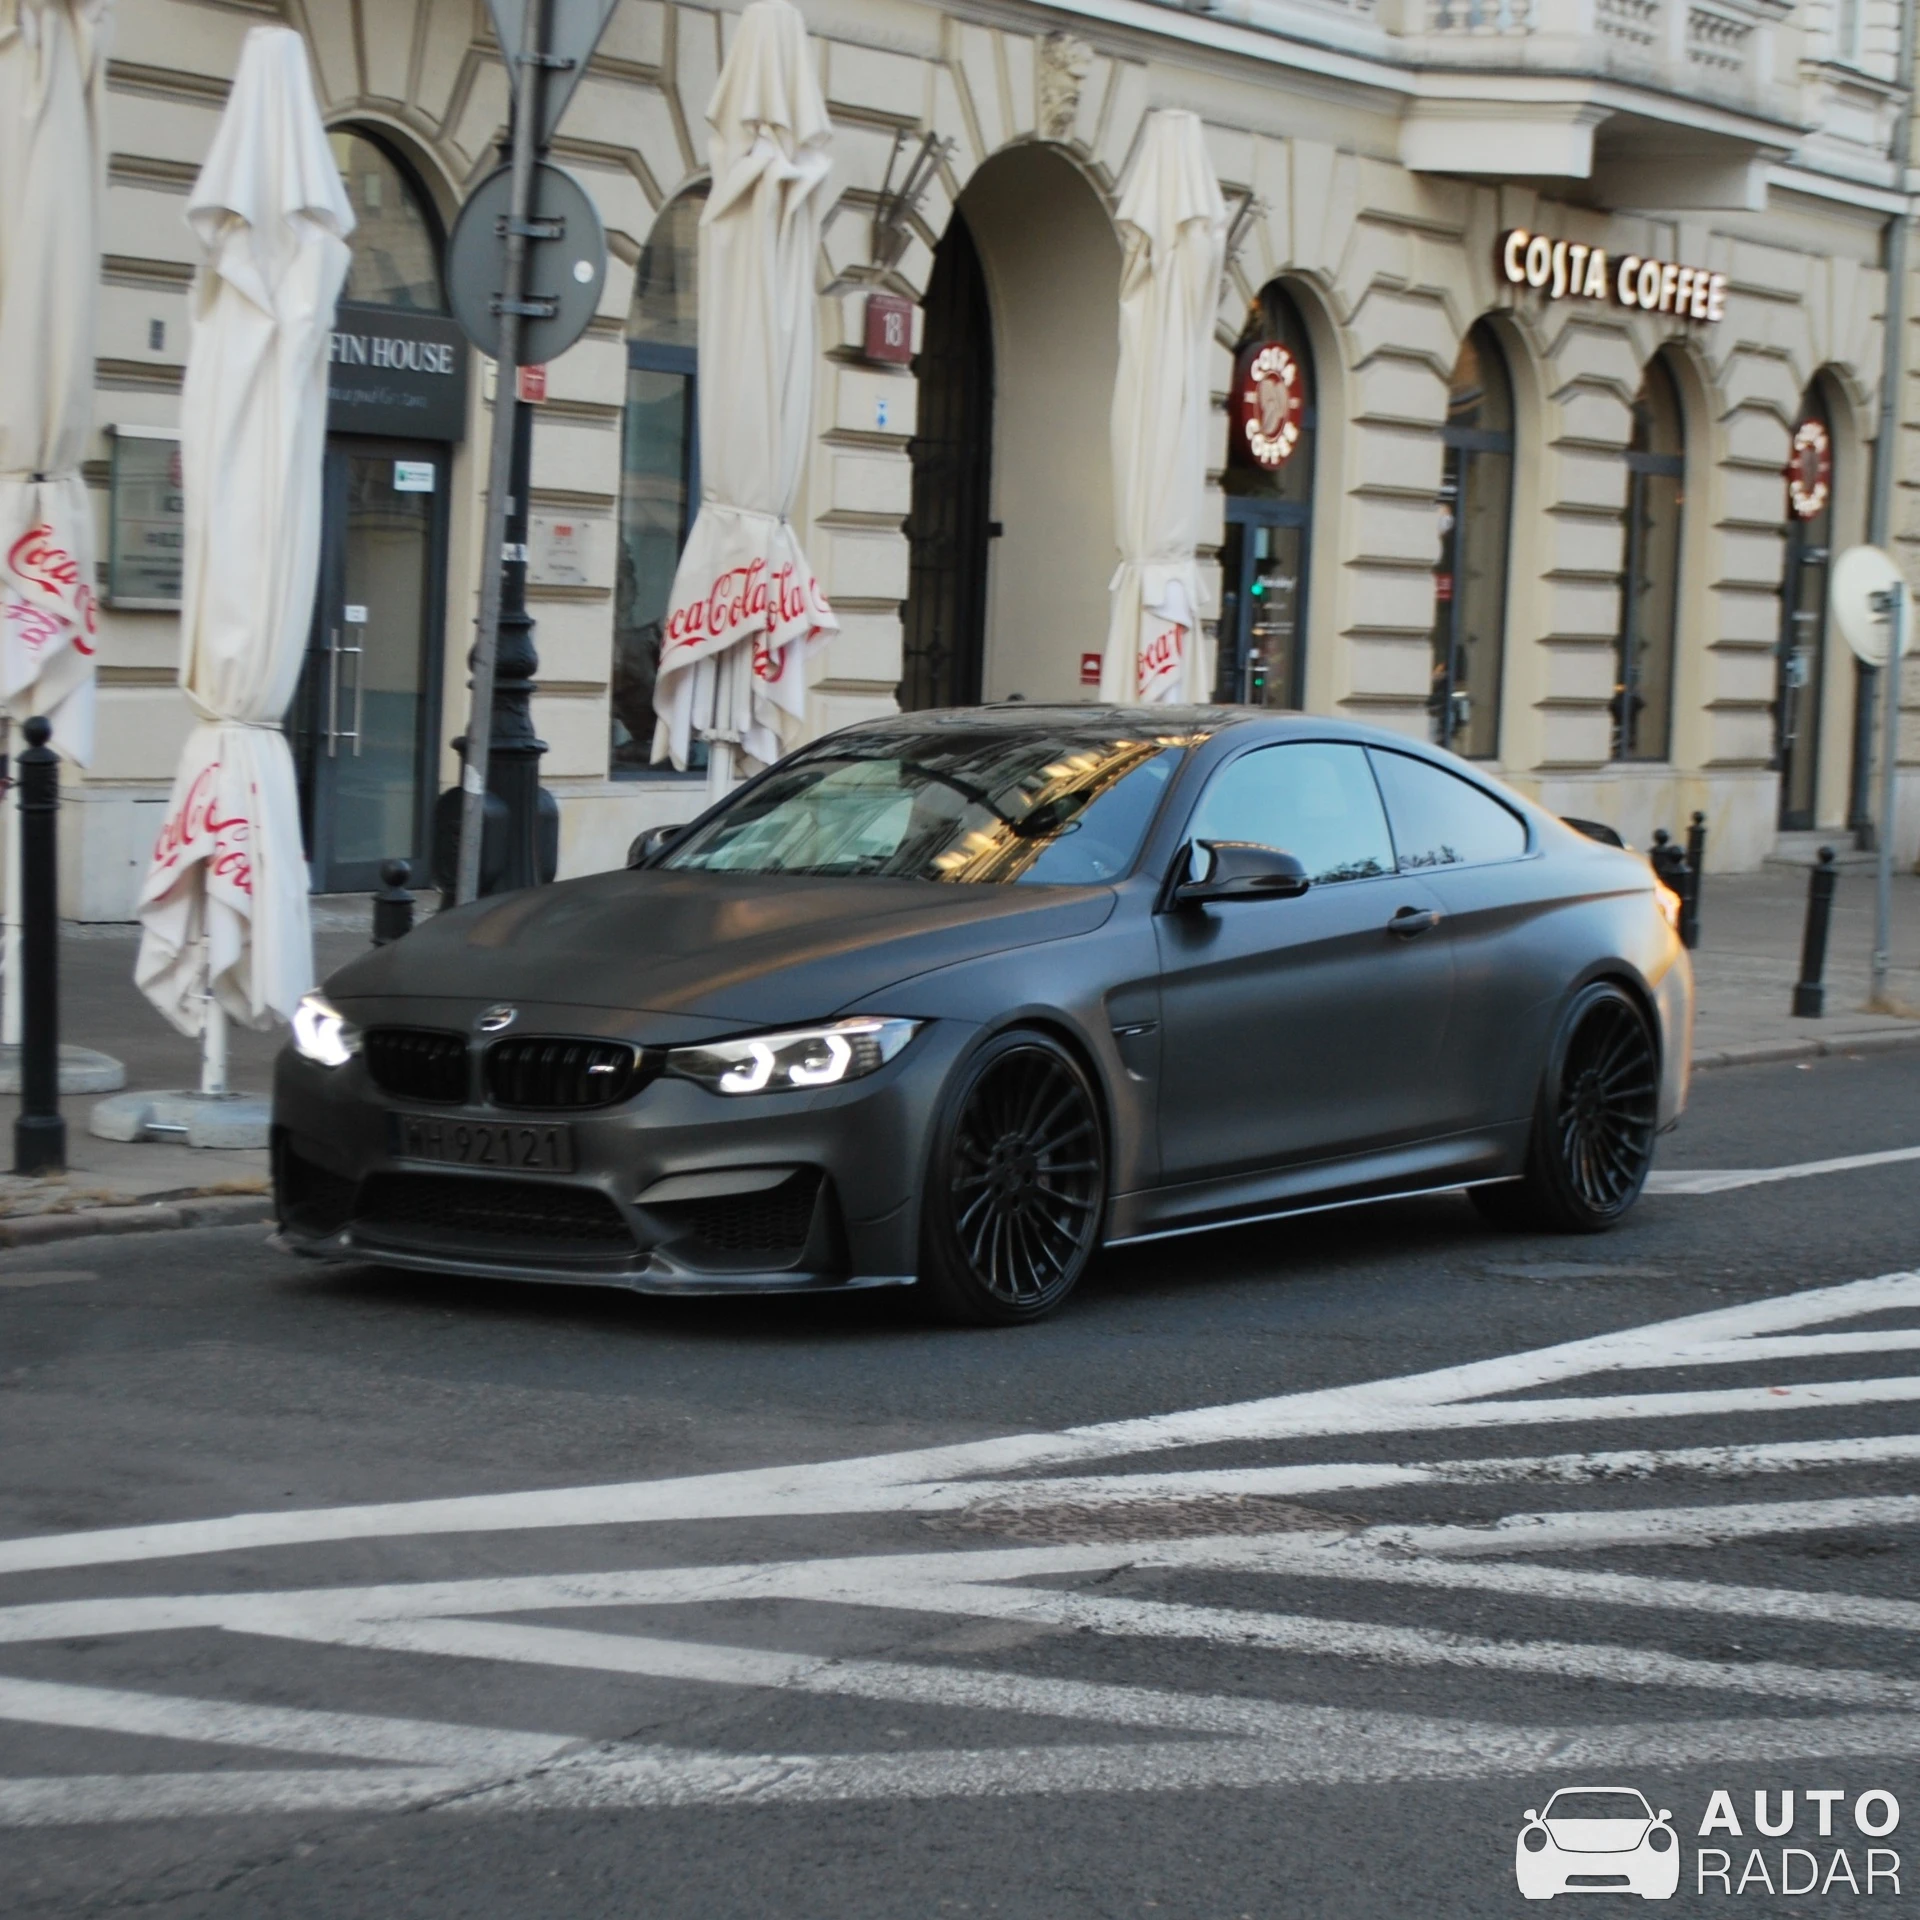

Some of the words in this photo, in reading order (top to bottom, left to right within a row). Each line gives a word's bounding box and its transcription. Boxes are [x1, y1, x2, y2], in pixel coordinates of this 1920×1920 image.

[1504, 229, 1607, 299] COSTA
[1618, 255, 1727, 322] COFFEE
[883, 311, 903, 347] 18
[372, 336, 454, 374] HOUSE
[454, 1124, 560, 1167] 92121
